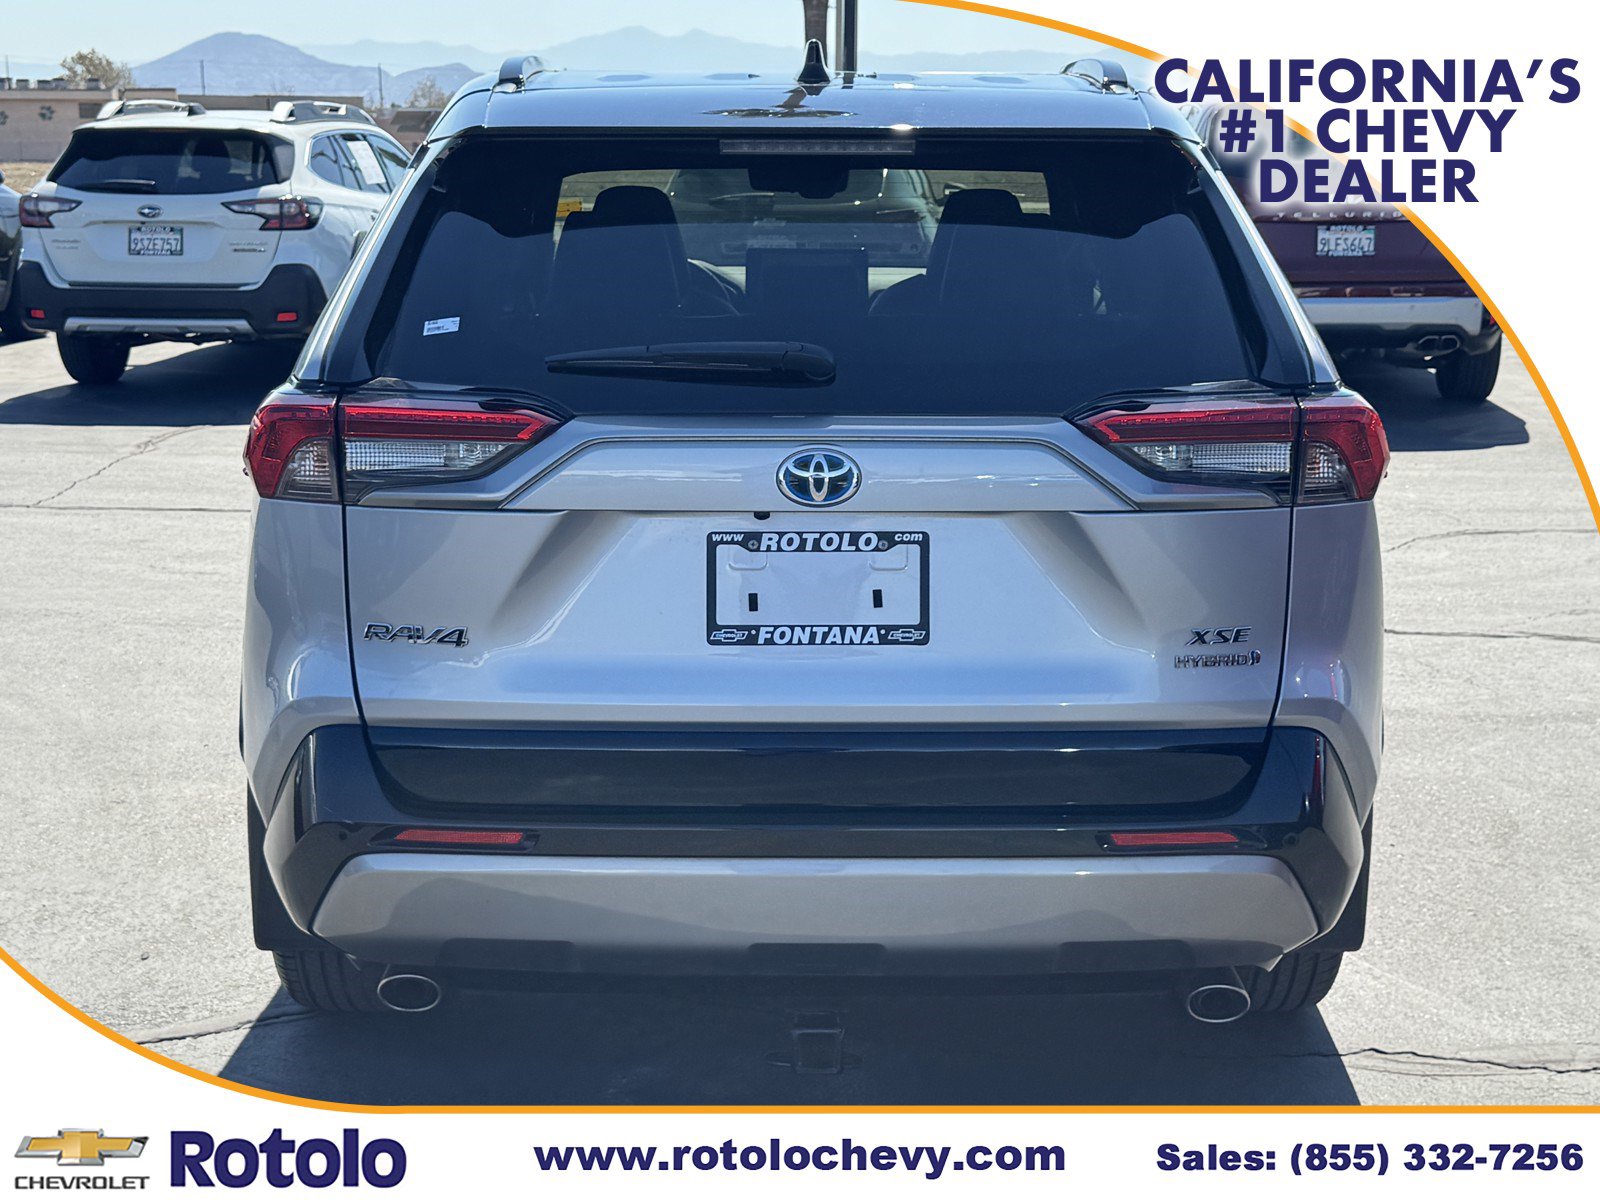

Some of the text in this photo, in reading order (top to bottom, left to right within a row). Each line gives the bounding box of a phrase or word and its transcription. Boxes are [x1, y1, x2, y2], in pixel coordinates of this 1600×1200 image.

[132, 237, 180, 251] 9SZE757
[1319, 237, 1373, 252] 9LFS647
[711, 532, 923, 551] www ROTOLO com
[363, 622, 469, 648] RAV4
[757, 626, 880, 645] FONTANA
[1185, 626, 1252, 646] XSE
[1174, 654, 1248, 668] HYBRID
